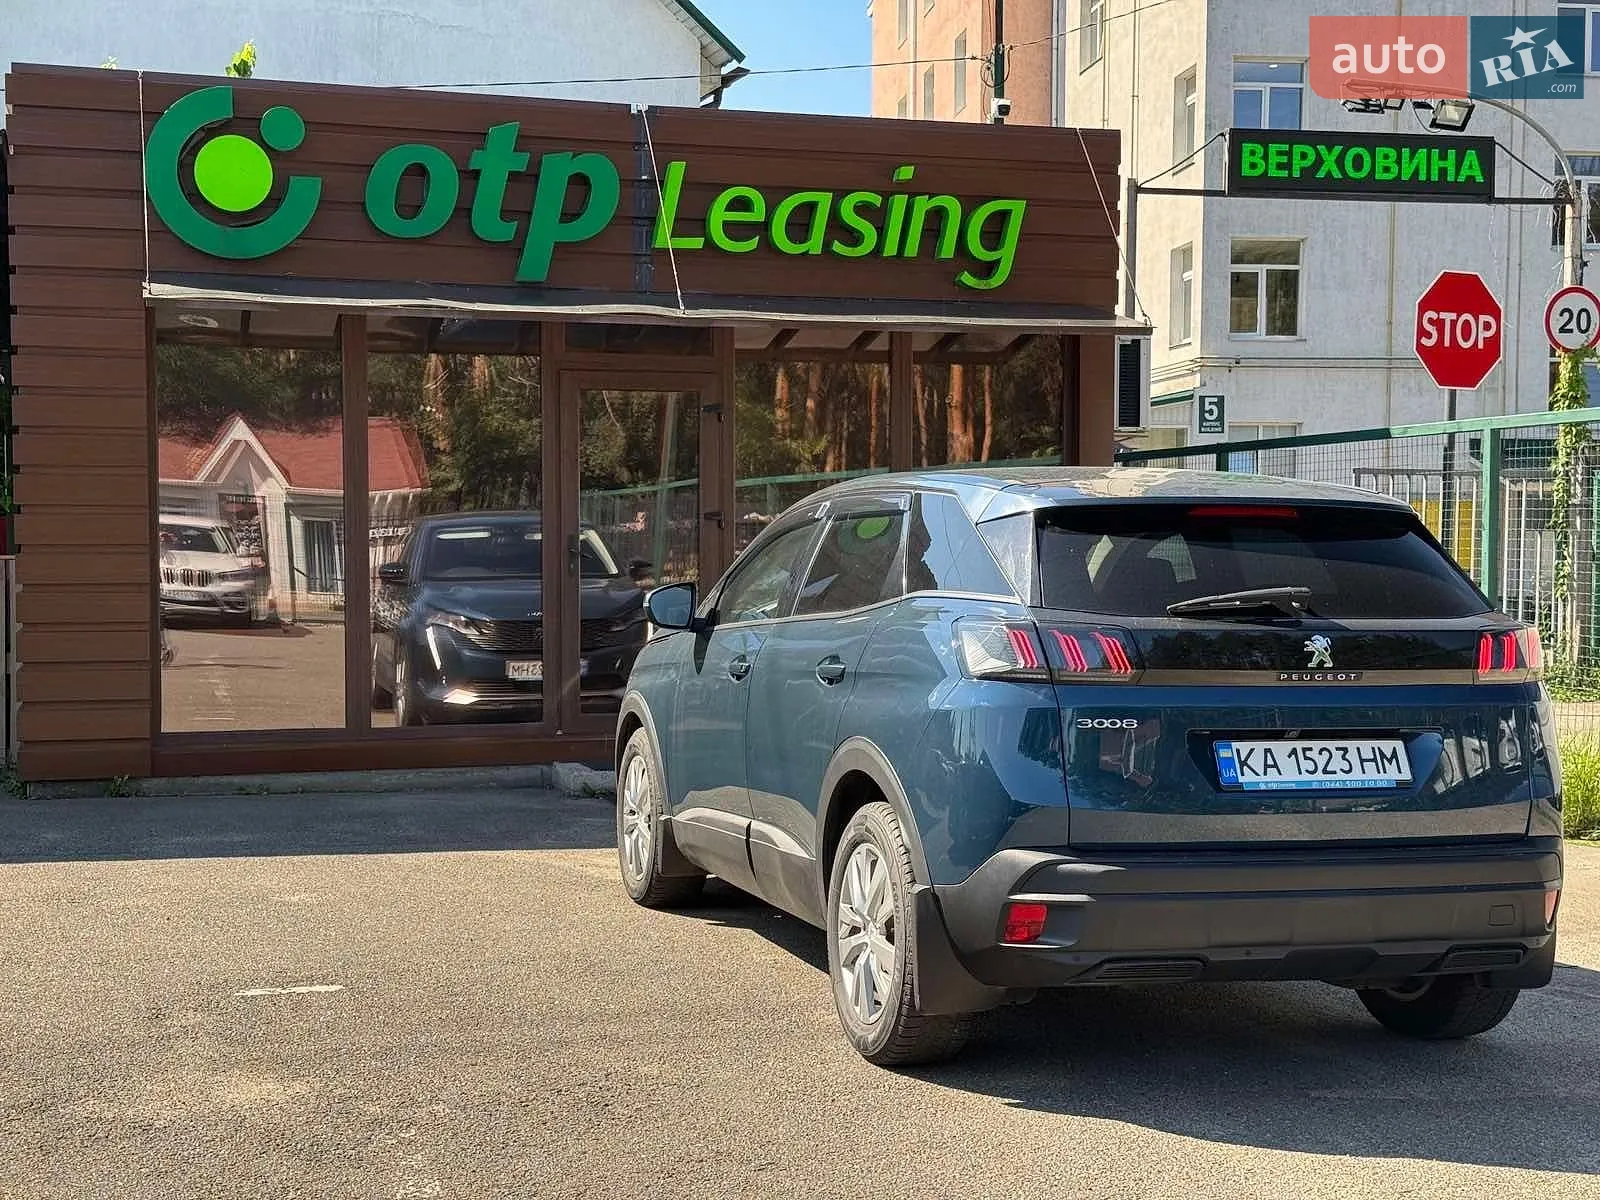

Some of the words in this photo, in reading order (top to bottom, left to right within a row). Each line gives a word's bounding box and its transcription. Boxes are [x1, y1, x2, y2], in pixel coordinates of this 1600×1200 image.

[1241, 141, 1485, 183] ВЕРХОВИНА
[365, 121, 621, 283] otp
[651, 161, 1027, 290] Leasing
[1420, 310, 1497, 350] STOP
[1558, 307, 1592, 335] 20
[1205, 397, 1218, 420] 5
[1280, 673, 1357, 681] PEUGEOT
[1077, 718, 1138, 728] 3008
[1222, 768, 1237, 778] UA
[1236, 747, 1282, 777] KA
[1287, 746, 1353, 776] 1523
[1356, 746, 1403, 775] HM
